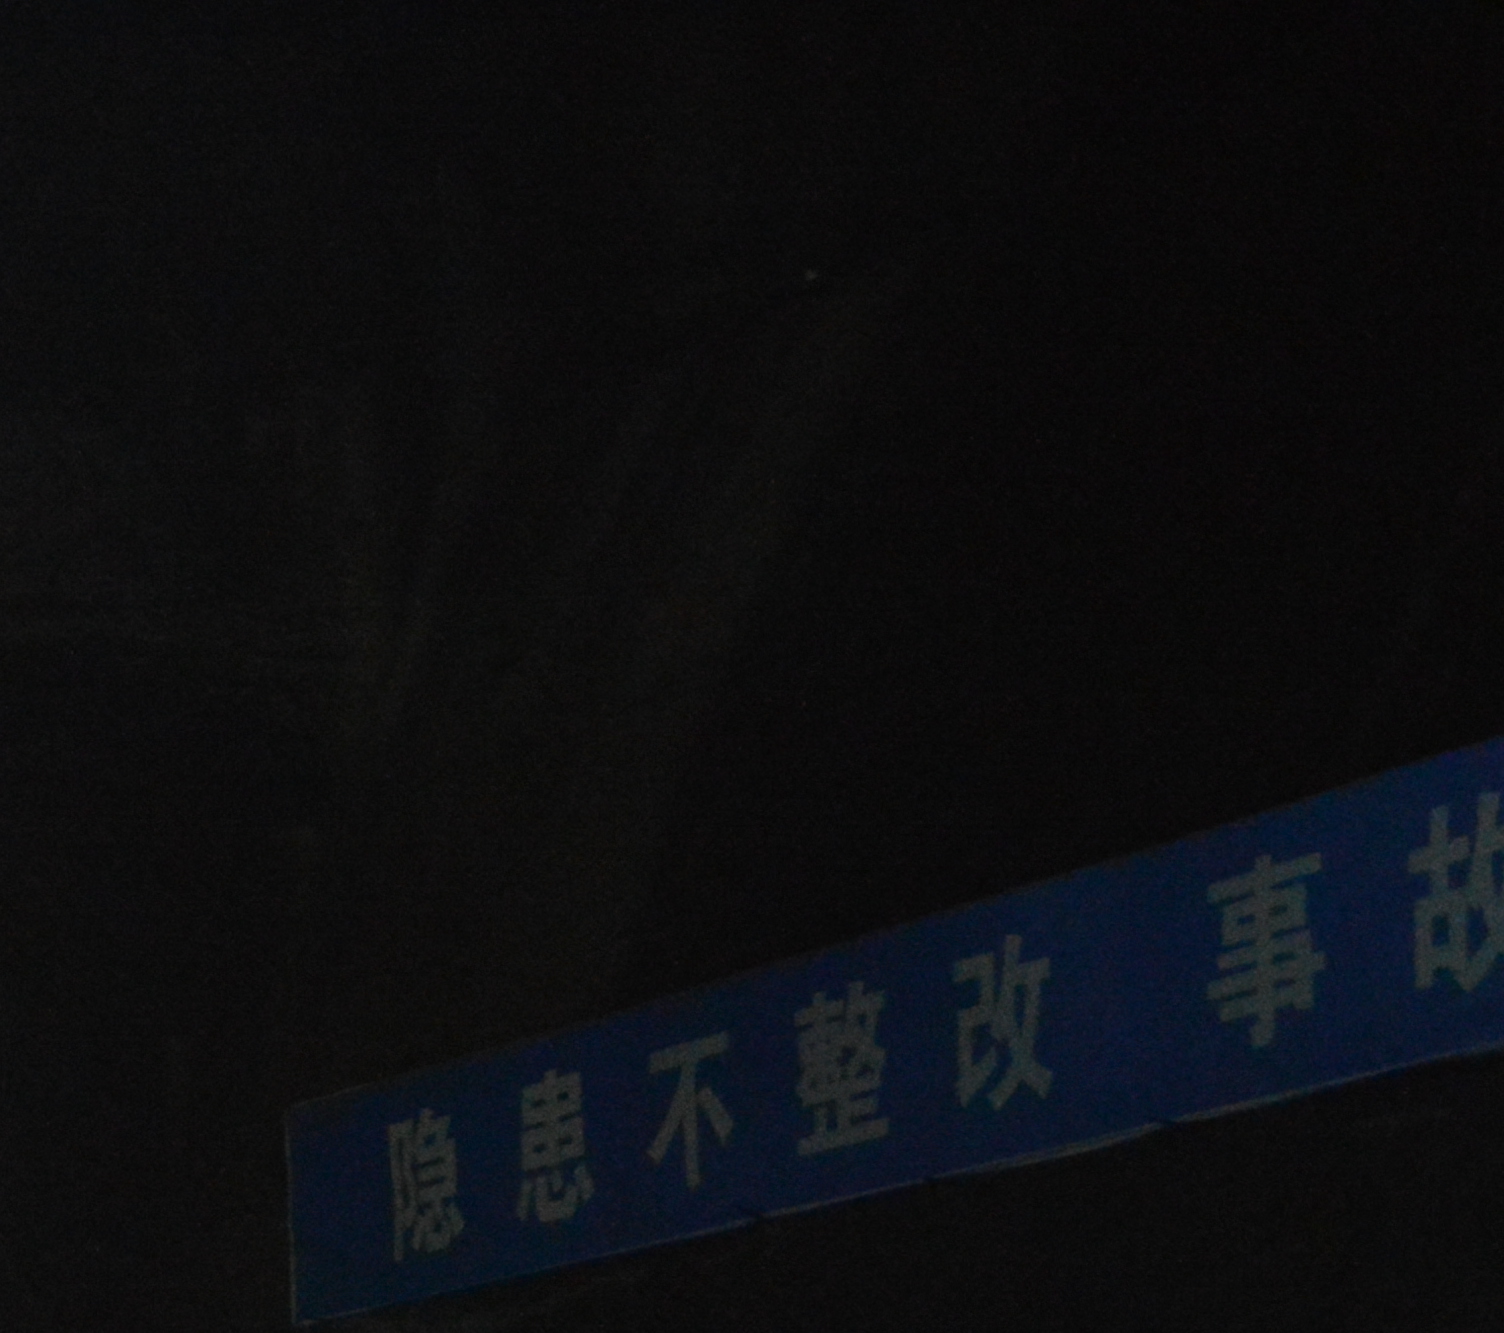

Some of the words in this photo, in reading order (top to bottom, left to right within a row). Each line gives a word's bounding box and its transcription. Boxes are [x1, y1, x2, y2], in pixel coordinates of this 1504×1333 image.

[386, 933, 1054, 1263] 隐患不整改
[1207, 792, 1504, 1048] 事故
